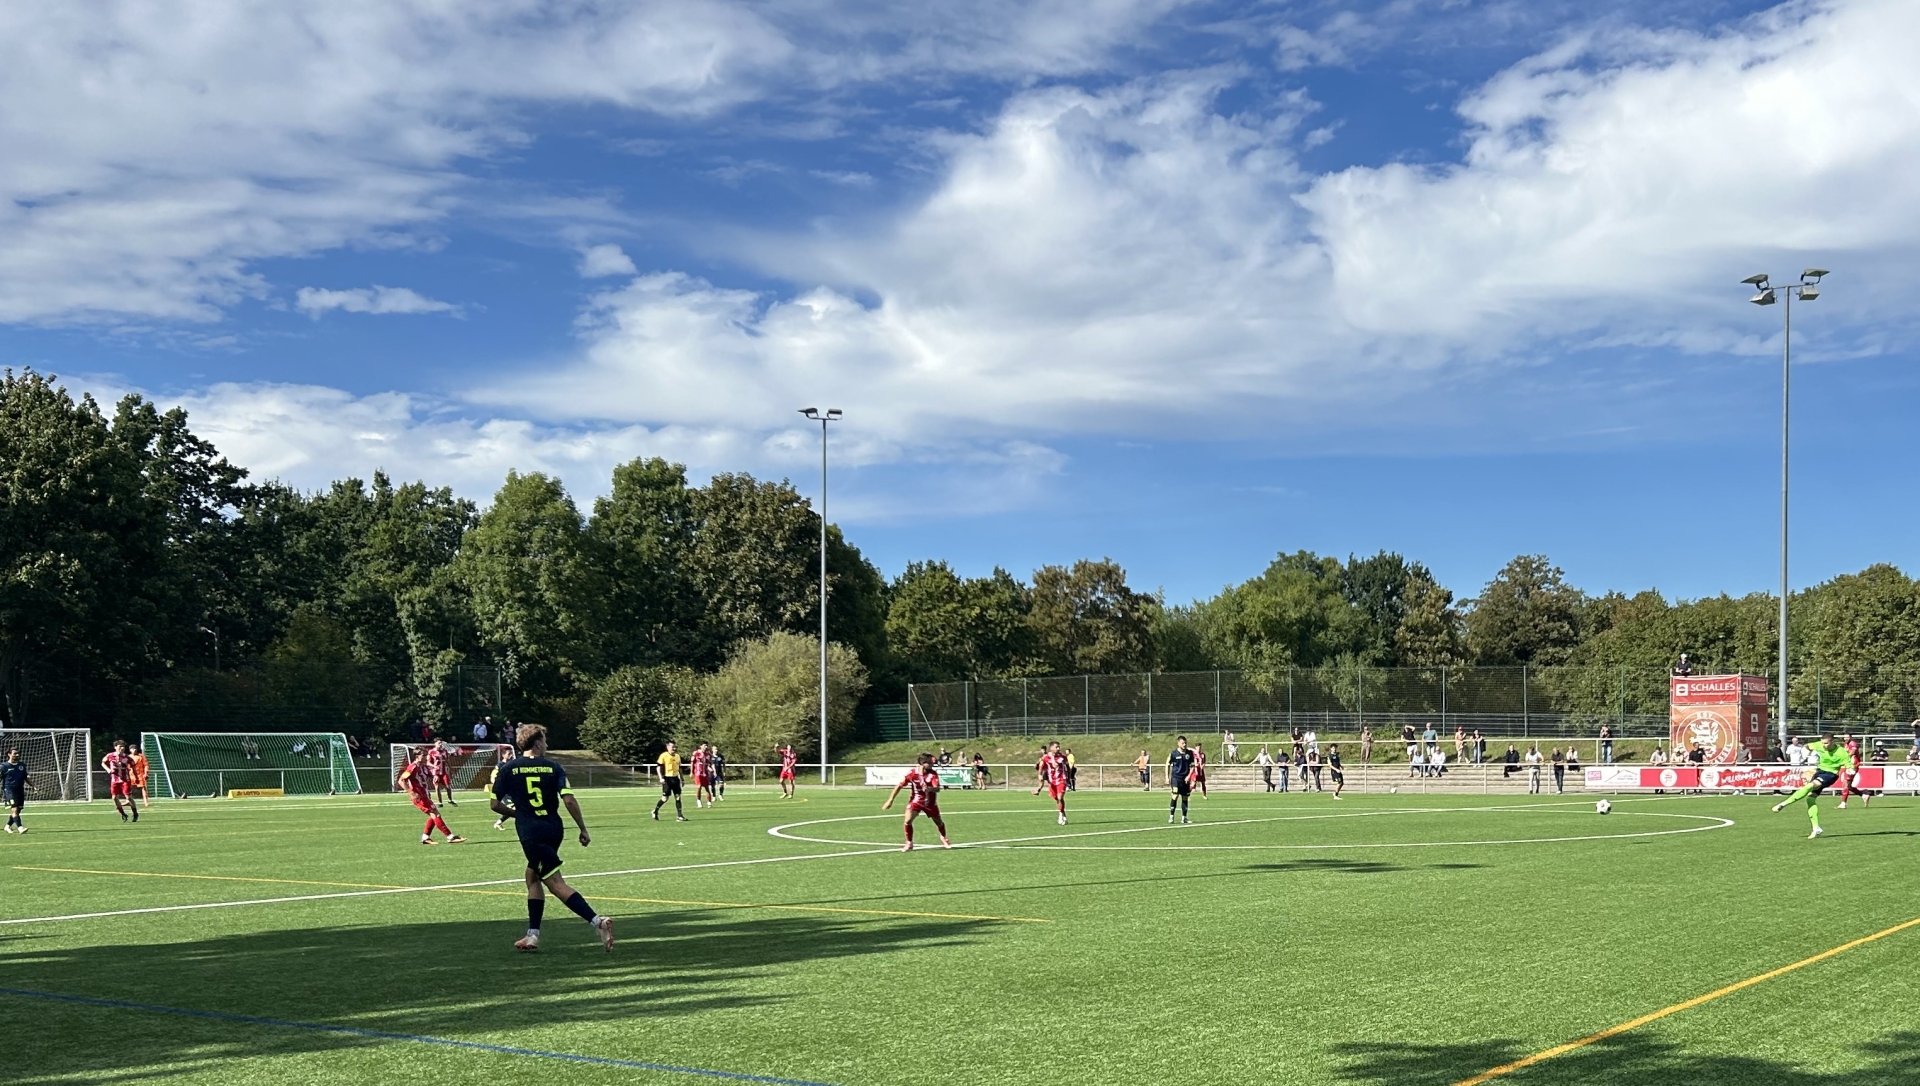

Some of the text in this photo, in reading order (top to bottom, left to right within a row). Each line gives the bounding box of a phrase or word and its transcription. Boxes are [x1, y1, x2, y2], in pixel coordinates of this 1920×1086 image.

[1690, 682, 1736, 692] SCHALLES
[1721, 770, 1761, 784] WILLKOMMEN
[1895, 768, 1920, 780] RO
[526, 776, 543, 808] 5
